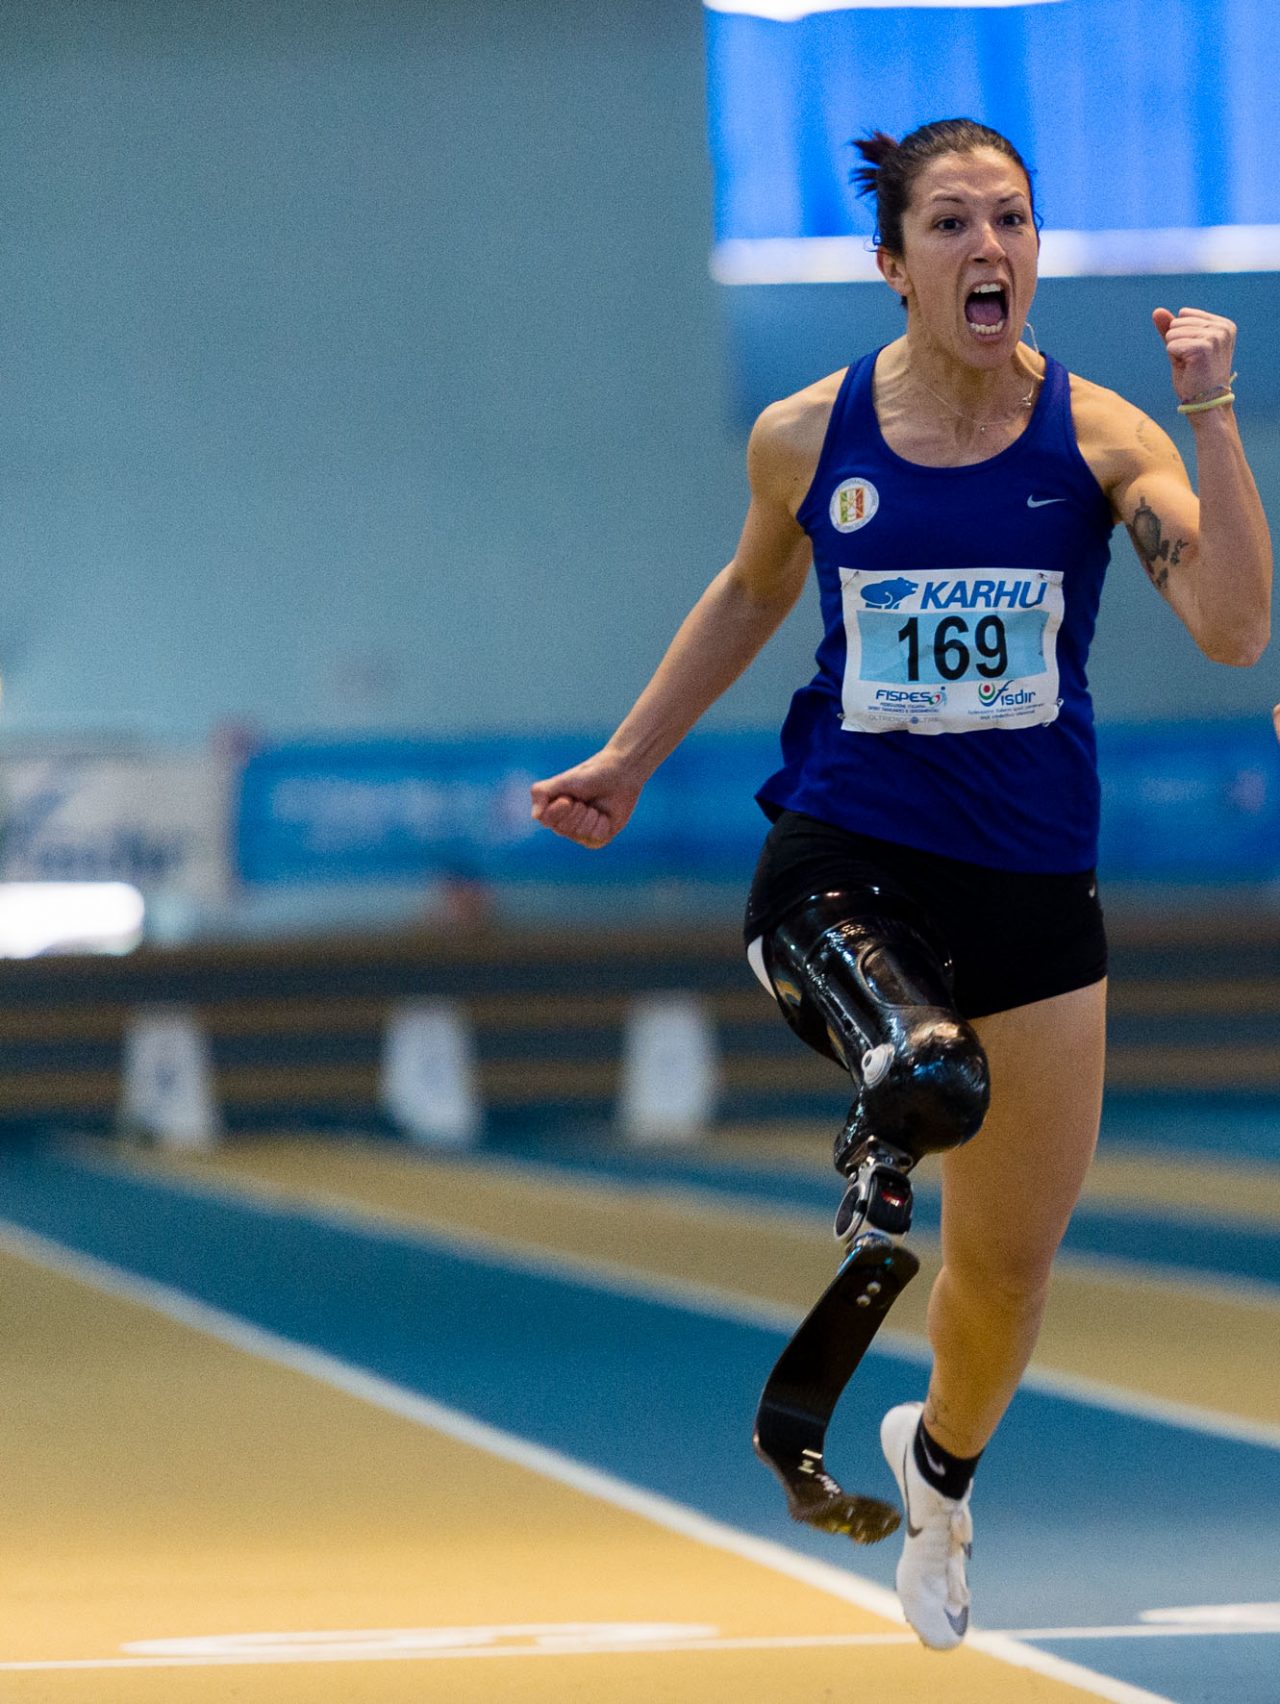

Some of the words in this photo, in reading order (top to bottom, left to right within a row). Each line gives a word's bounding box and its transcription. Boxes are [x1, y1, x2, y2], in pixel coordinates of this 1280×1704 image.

[920, 580, 1048, 610] KARHU
[898, 614, 1008, 682] 169
[875, 689, 931, 703] FISPES
